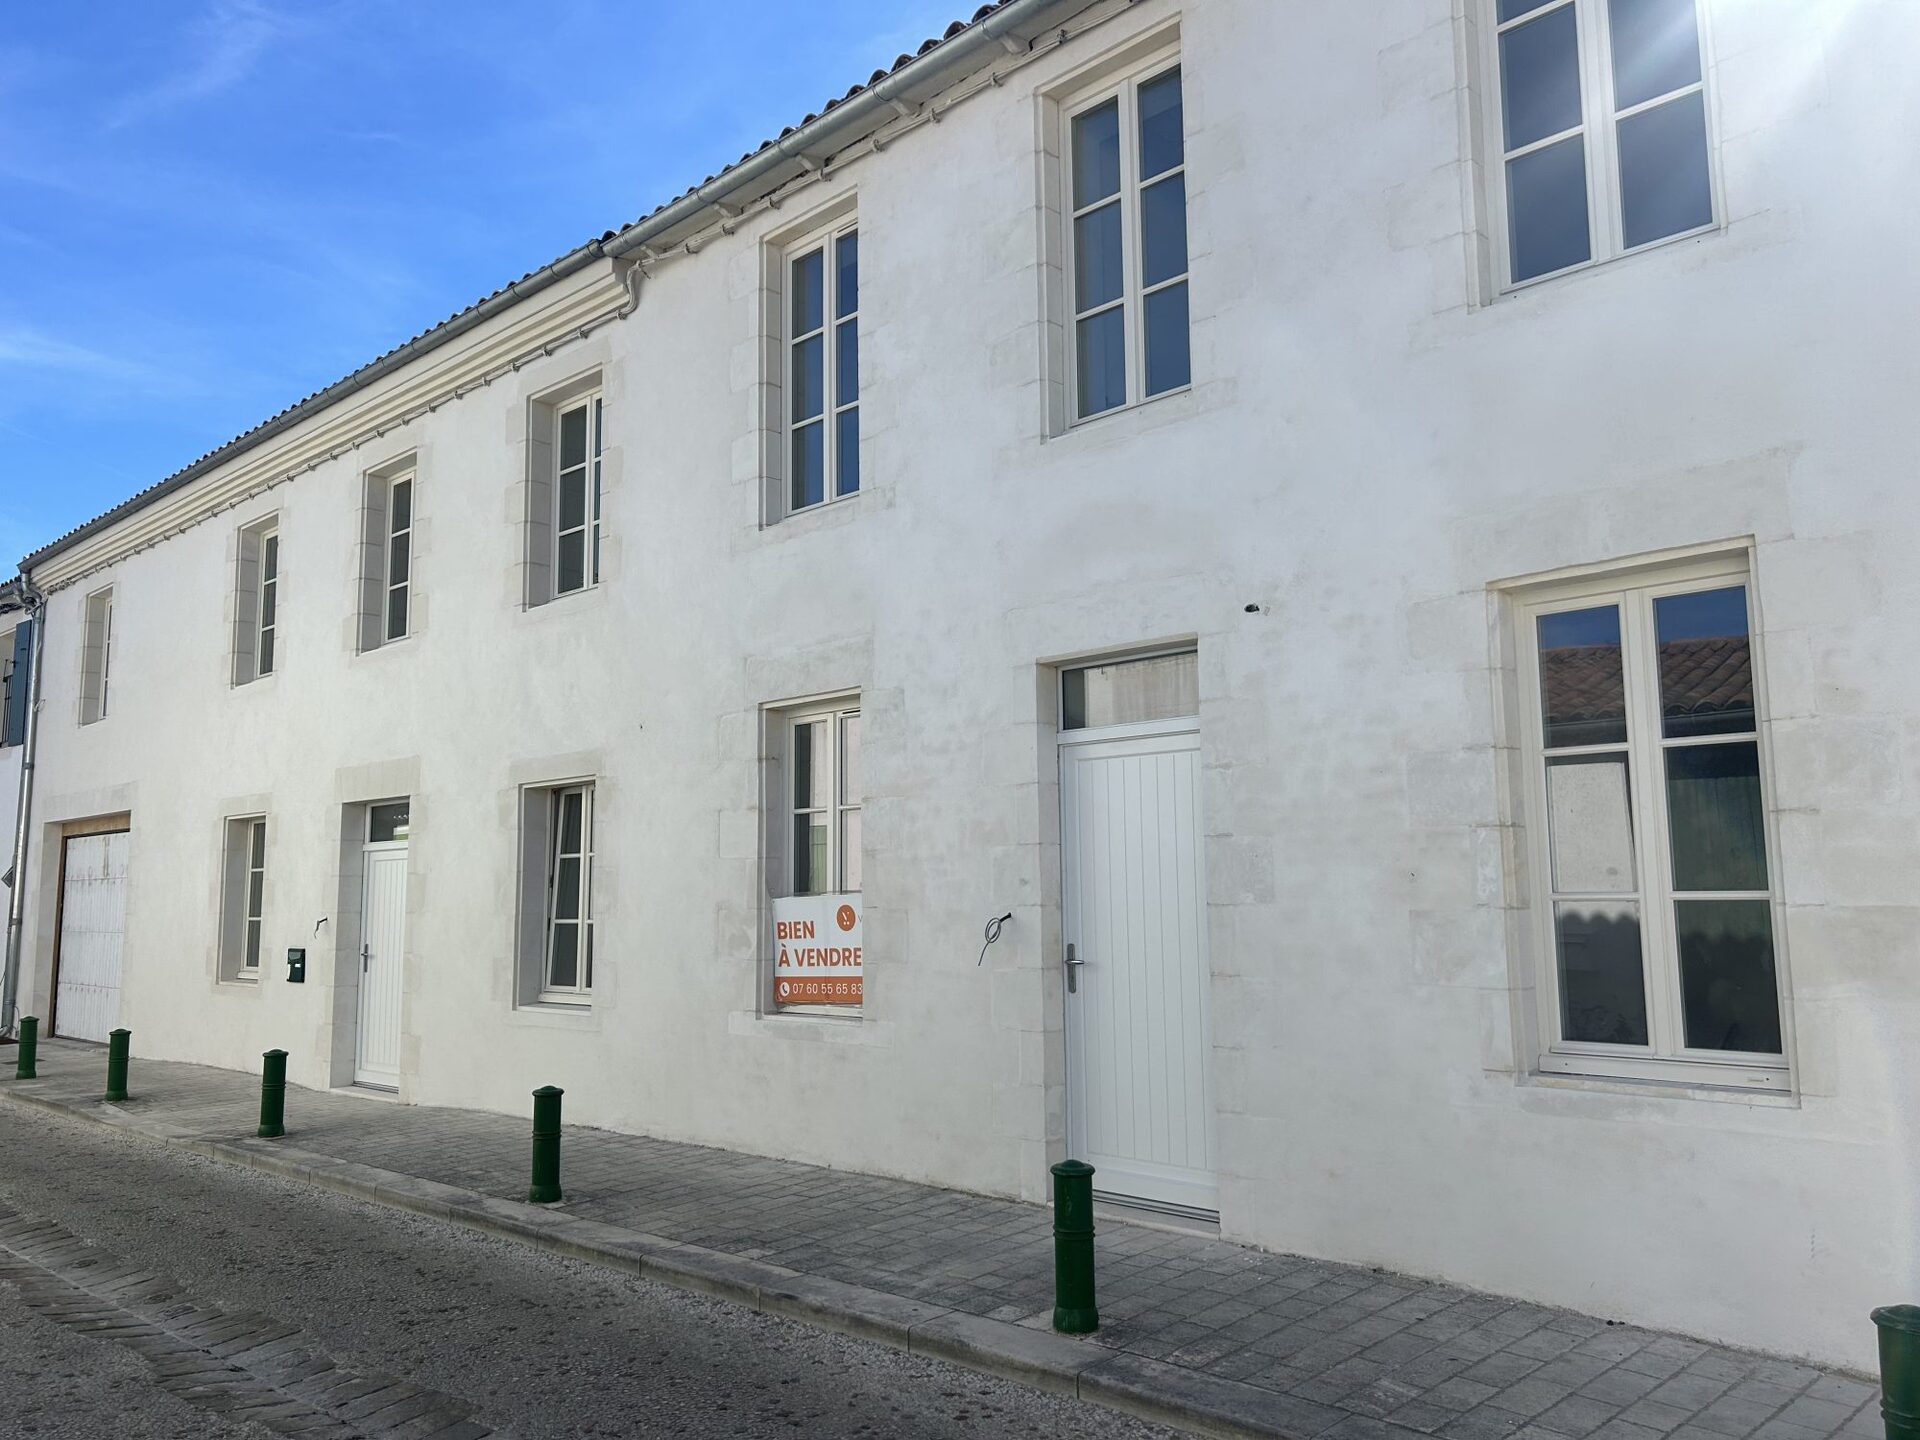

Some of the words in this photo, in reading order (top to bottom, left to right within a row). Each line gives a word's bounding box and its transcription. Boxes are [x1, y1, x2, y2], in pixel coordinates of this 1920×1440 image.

[776, 920, 815, 940] BIEN
[778, 943, 791, 968] À
[794, 947, 862, 968] VENDRE
[792, 983, 804, 994] 07
[806, 983, 818, 994] 60
[821, 983, 833, 994] 55
[836, 983, 848, 995] 65
